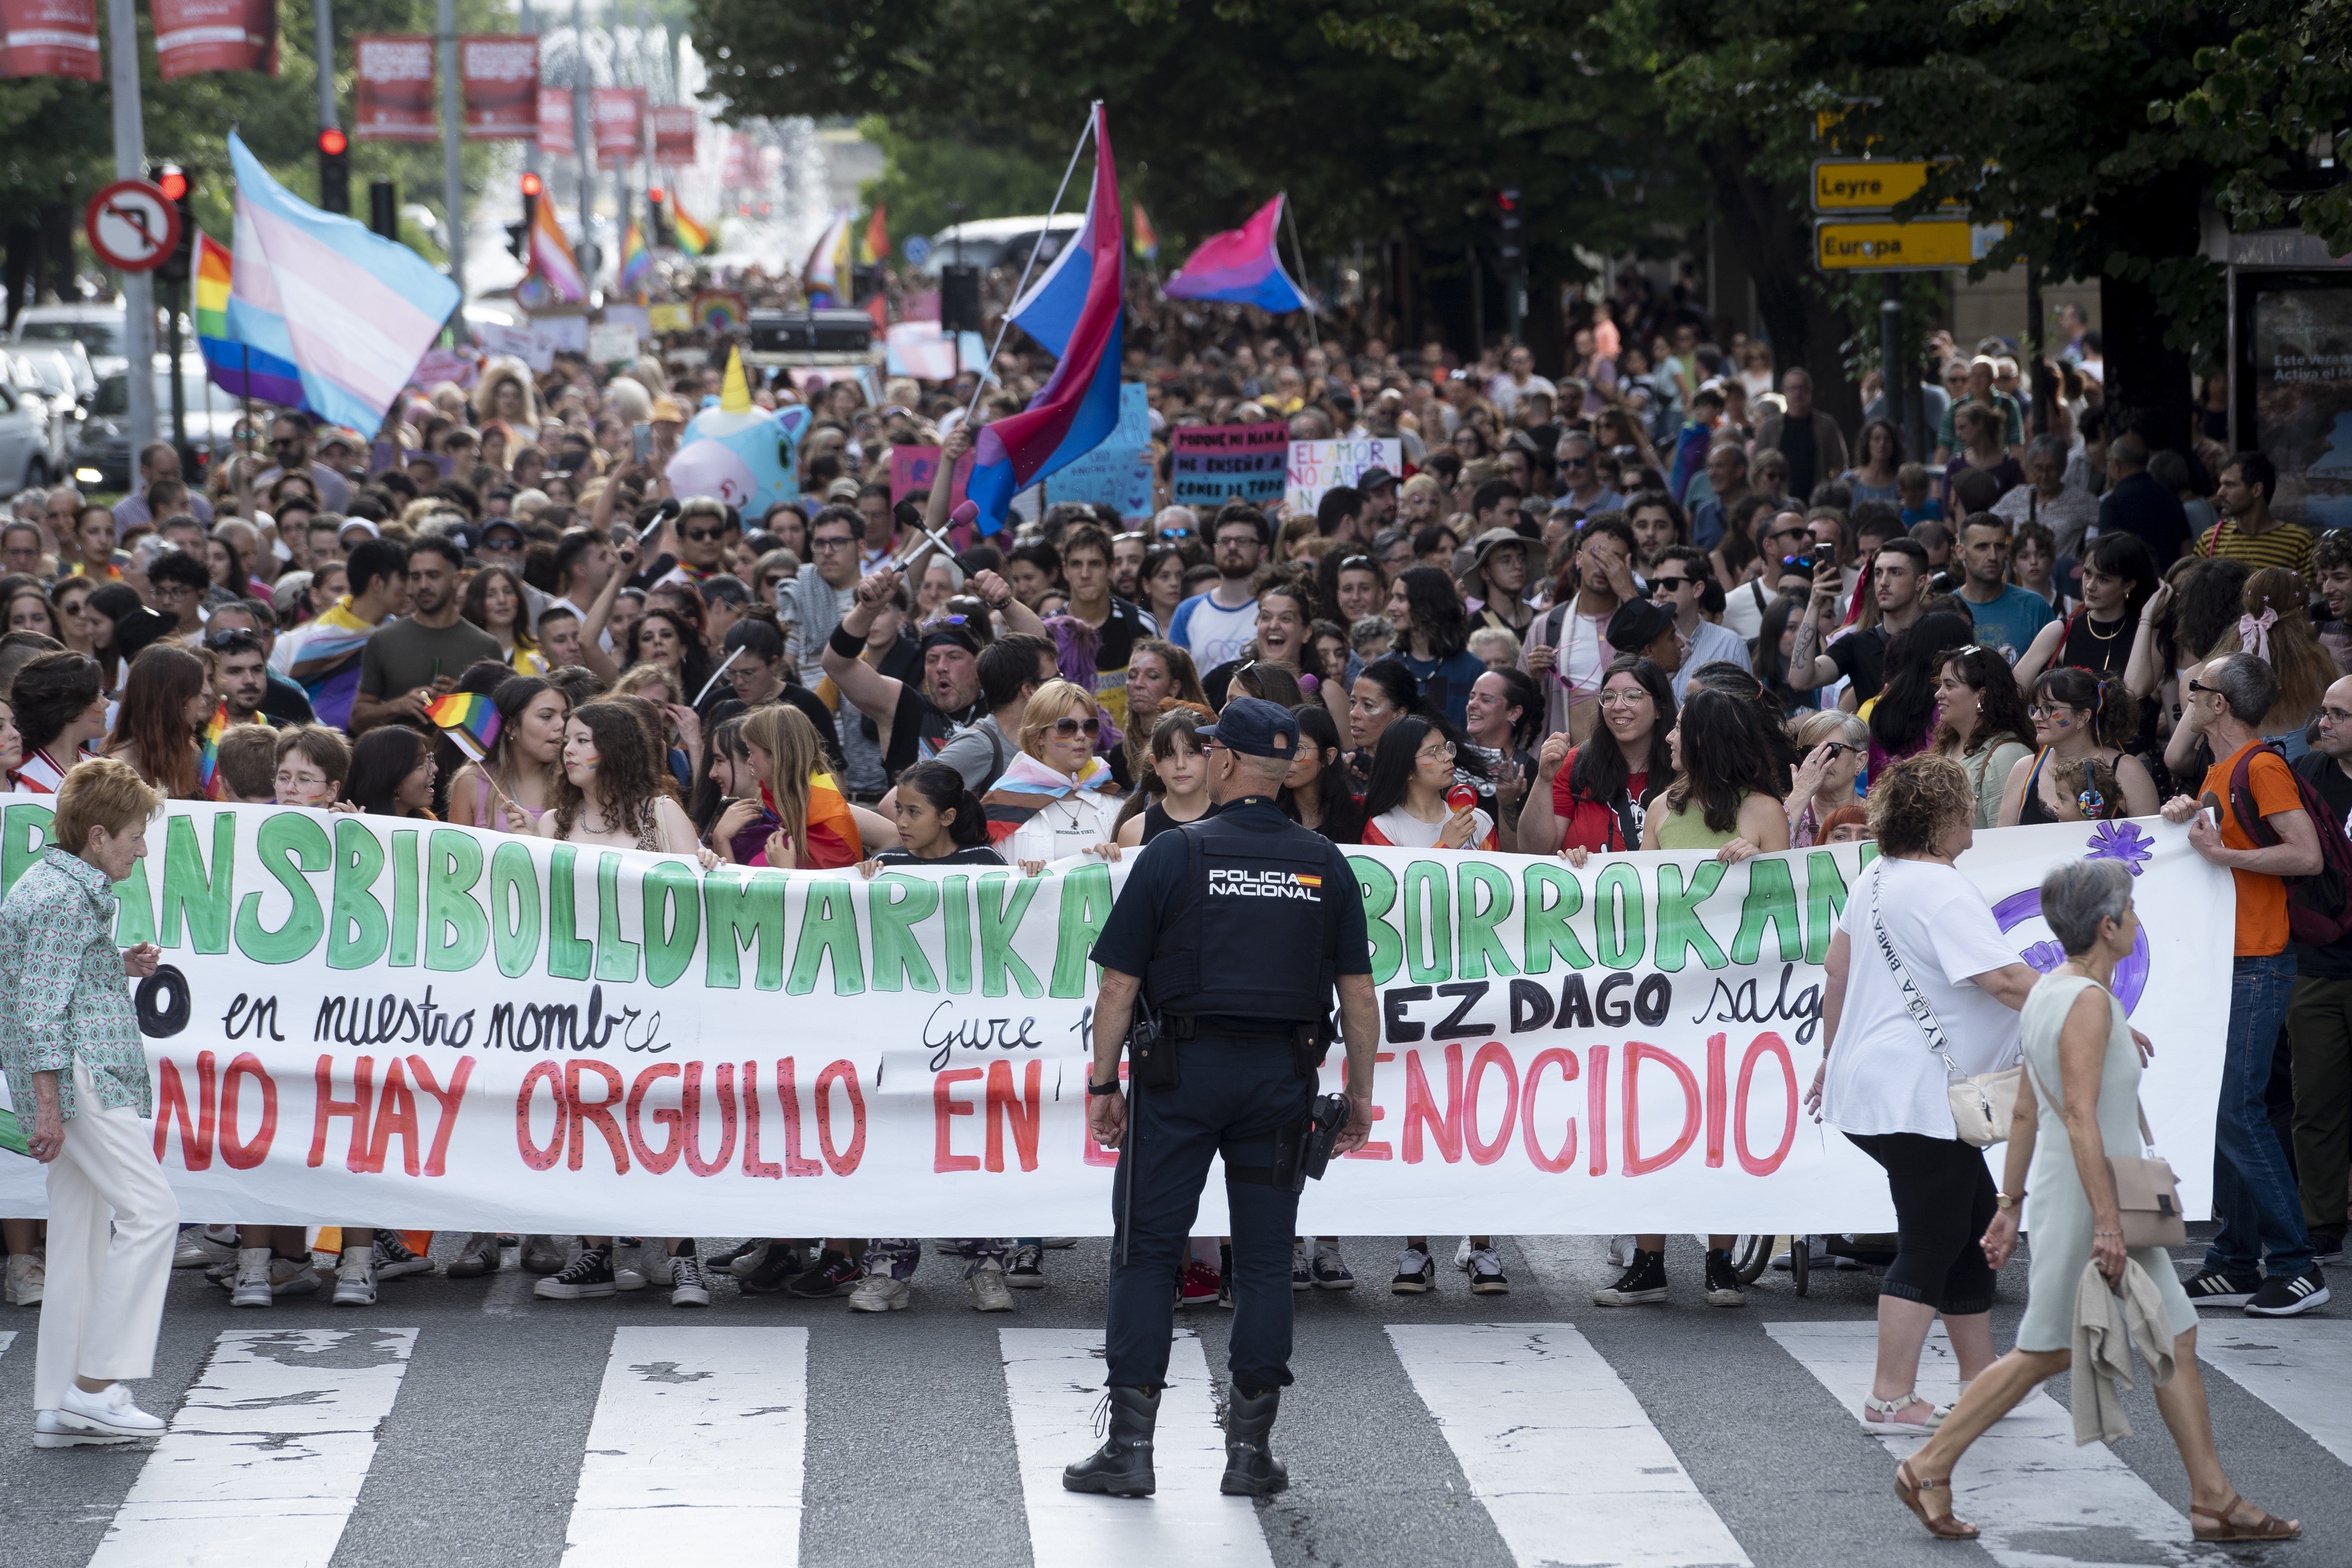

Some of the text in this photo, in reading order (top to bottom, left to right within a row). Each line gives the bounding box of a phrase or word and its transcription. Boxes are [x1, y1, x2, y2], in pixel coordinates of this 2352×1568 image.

[1821, 177, 1882, 198] Leyre
[2274, 354, 2352, 366] Este veran
[2274, 367, 2318, 381] Activa
[2322, 366, 2335, 379] el
[1179, 433, 1225, 447] PORQUE
[1229, 434, 1243, 446] MI
[1178, 458, 1197, 470] ME
[1272, 456, 1281, 470] A
[1296, 441, 1384, 464] EL AMOR
[1287, 465, 1318, 488] NO
[1319, 463, 1367, 487] CABE
[1177, 479, 1284, 496] COMER DE TODO
[1286, 489, 1313, 513] UN
[1209, 883, 1321, 902] NACIONAL
[1875, 917, 1902, 971] BIMBA
[222, 992, 285, 1042] en
[314, 985, 476, 1049] nuestro
[483, 985, 671, 1053] nombre
[1383, 981, 1497, 1044] EZ
[1510, 971, 1672, 1033] DAGO
[1692, 963, 1824, 1045] salg
[153, 1051, 278, 1172] NO
[307, 1054, 477, 1178] HAY
[515, 1056, 868, 1181] ORGULLO
[933, 1058, 1043, 1174] EN
[1312, 1030, 1798, 1178] ENOCIDIO
